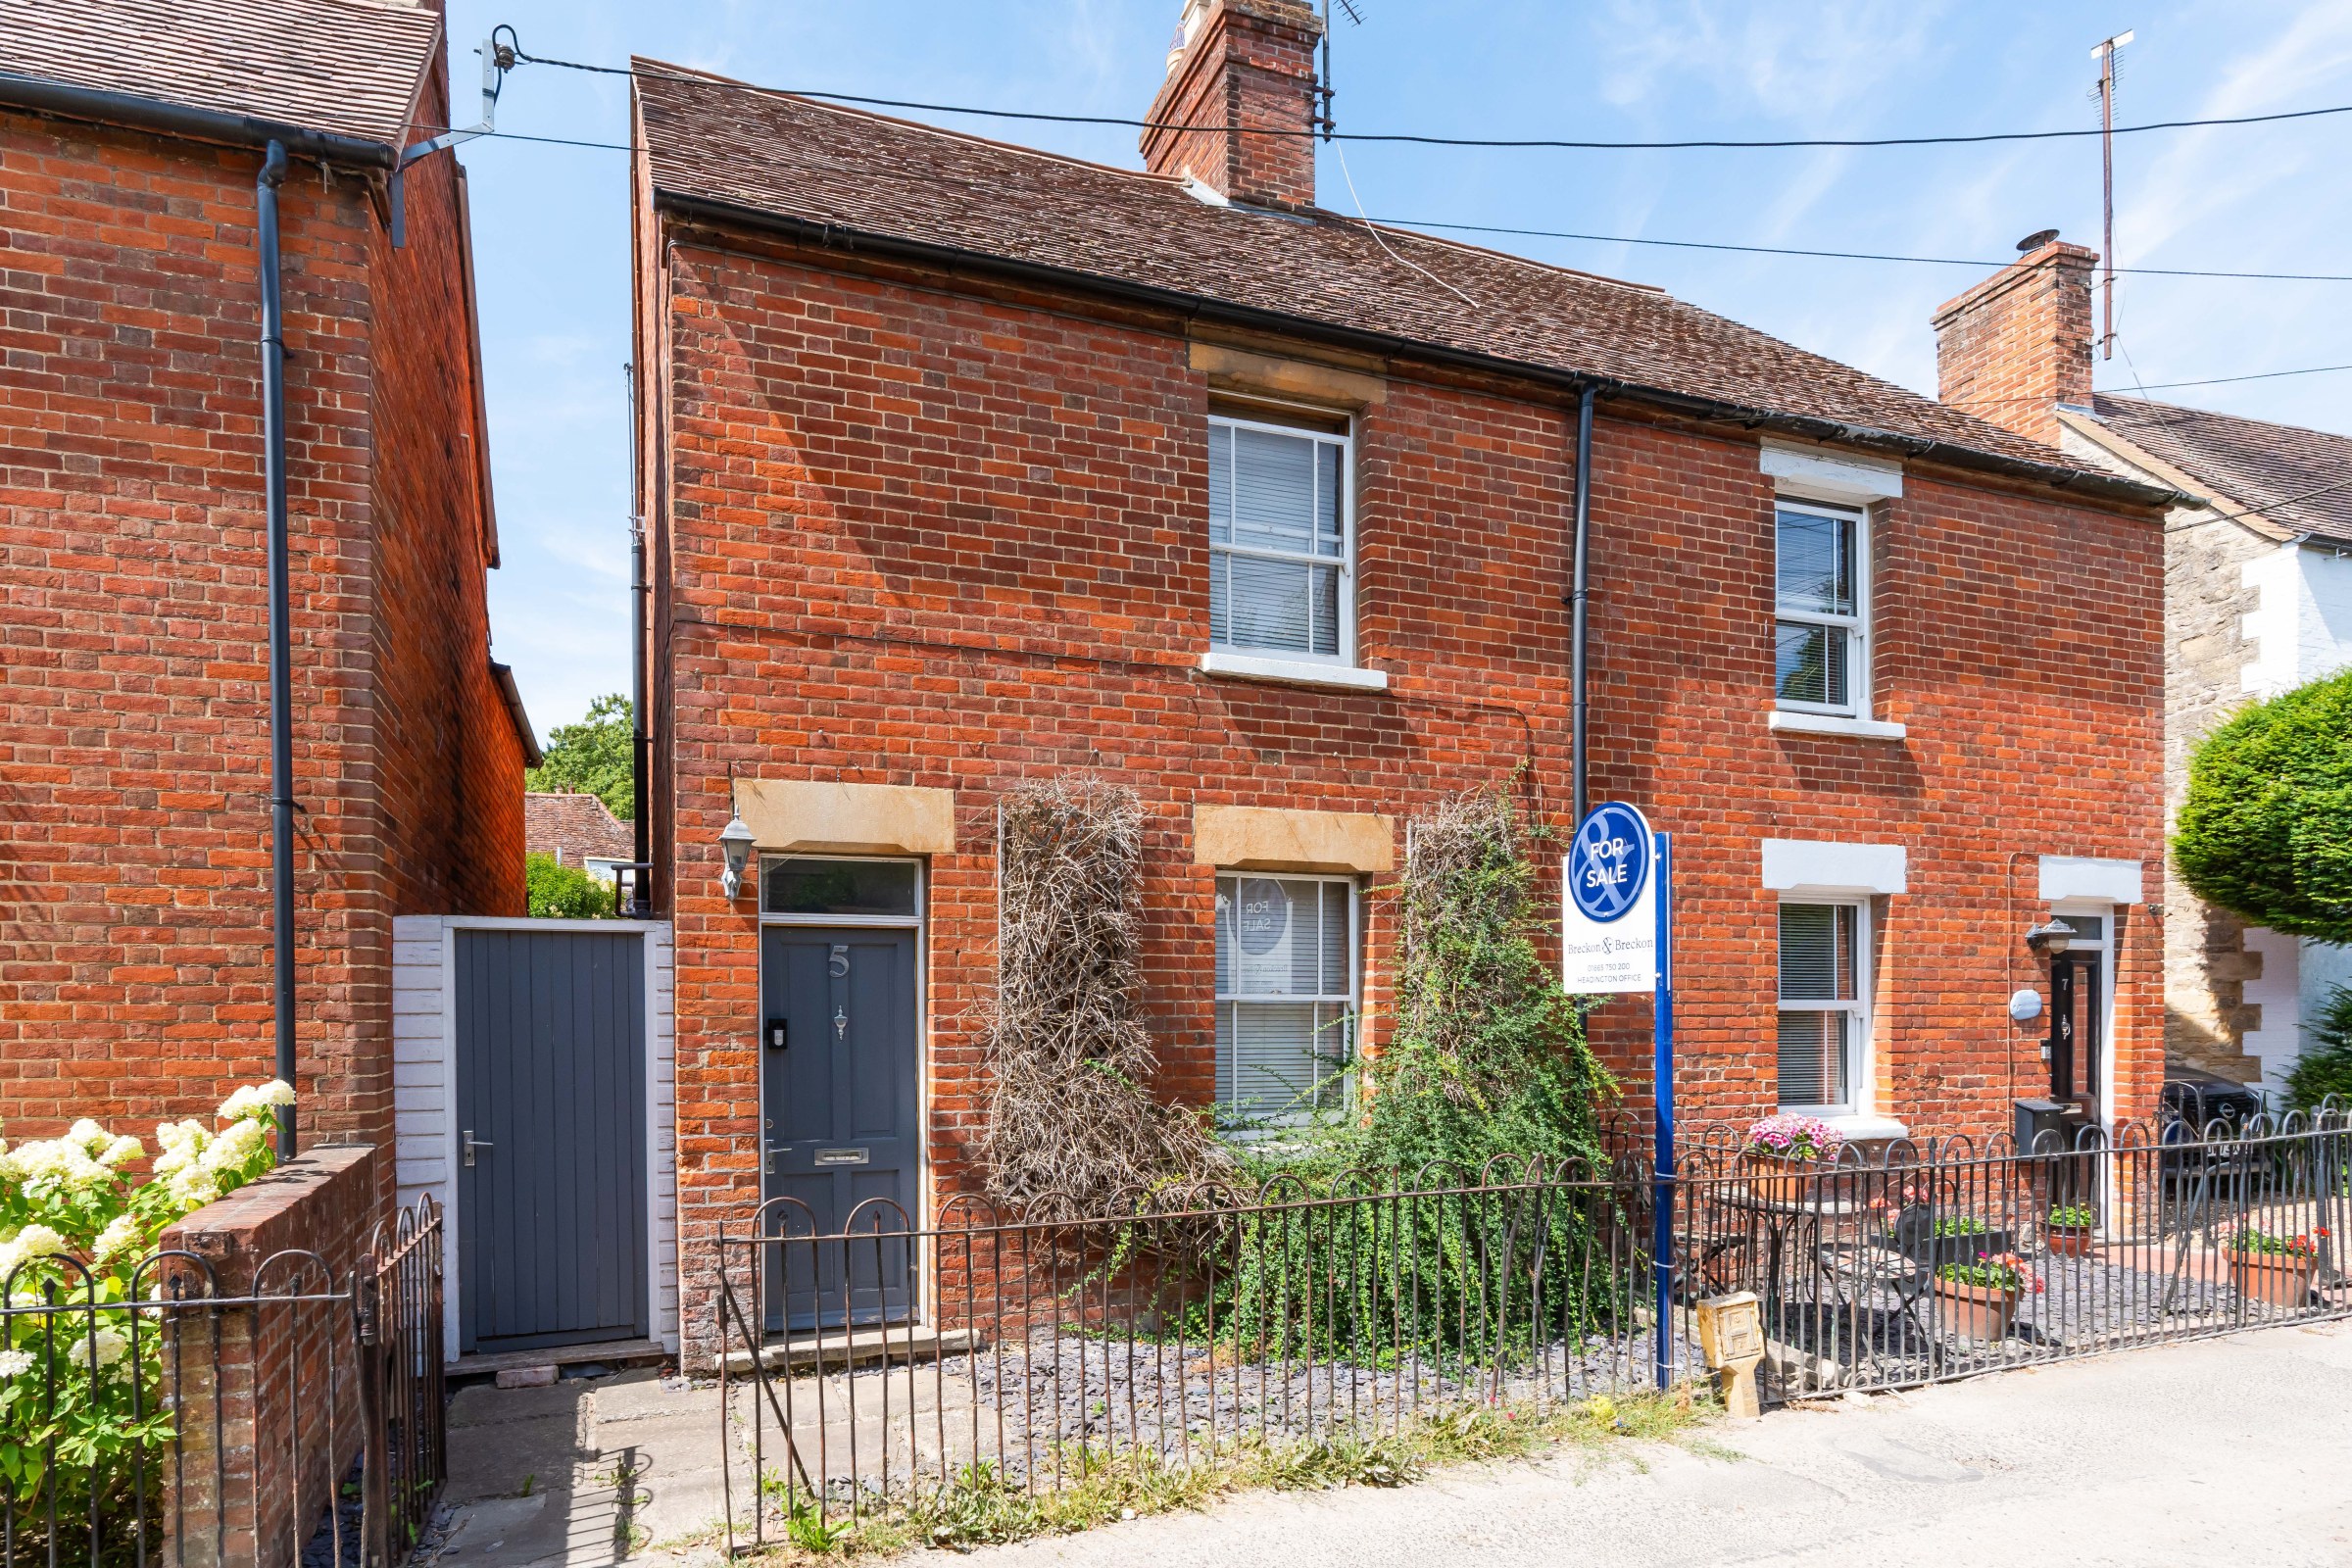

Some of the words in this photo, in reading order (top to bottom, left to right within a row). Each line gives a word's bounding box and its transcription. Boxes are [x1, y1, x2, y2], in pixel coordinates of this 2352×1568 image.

[1591, 837, 1624, 861] FOR
[1586, 863, 1628, 888] SALE
[1568, 942, 1601, 955] Breckon
[1602, 937, 1614, 955] &
[1615, 937, 1653, 951] Breckon
[829, 945, 850, 978] 5
[1619, 973, 1642, 982] OFFICE
[2062, 978, 2069, 991] 7
